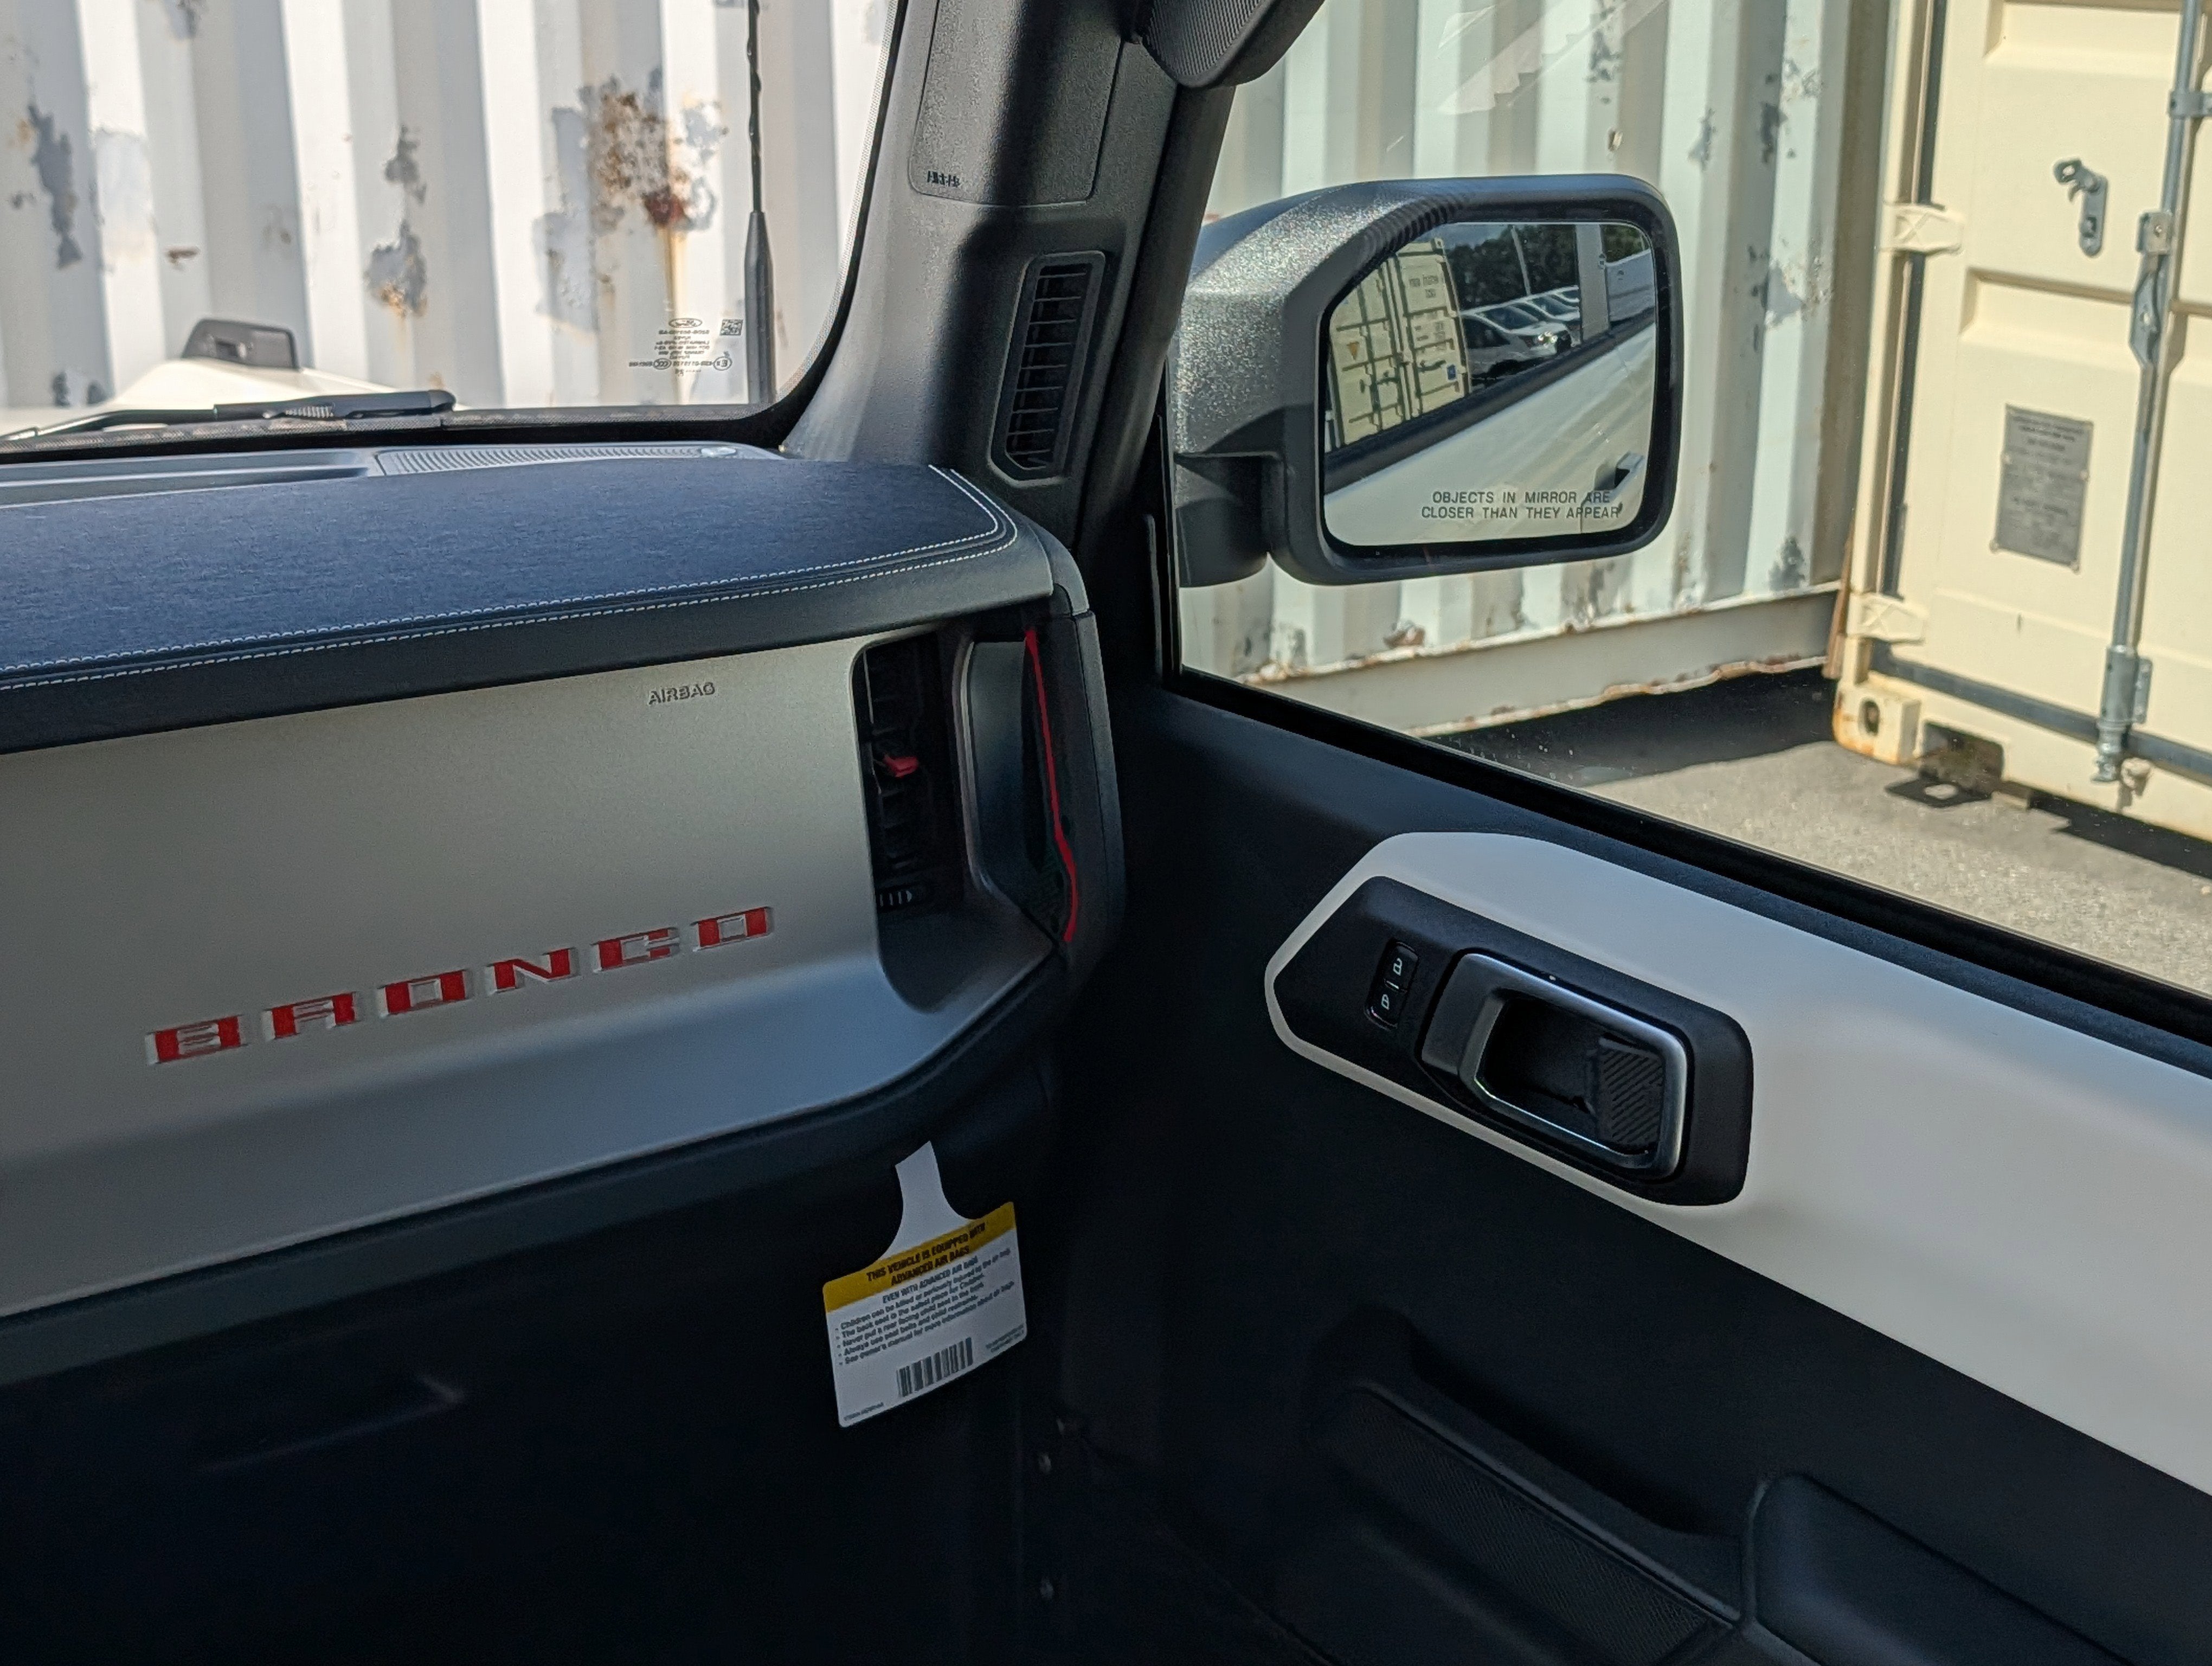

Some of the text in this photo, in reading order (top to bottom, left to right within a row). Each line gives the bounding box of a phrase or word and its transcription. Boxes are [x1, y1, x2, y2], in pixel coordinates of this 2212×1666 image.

[1421, 505, 1619, 519] CLOSER THAN THEY APPEAR
[1432, 490, 1611, 504] OBJECTS IN MIRROR ARE
[648, 681, 716, 705] AIRBAG
[145, 906, 772, 1066] BRONCO
[866, 1222, 986, 1282] THIS VEHICLE IS EQUIPPED WITH
[892, 1245, 970, 1286] ADVANCED AIR BAGS
